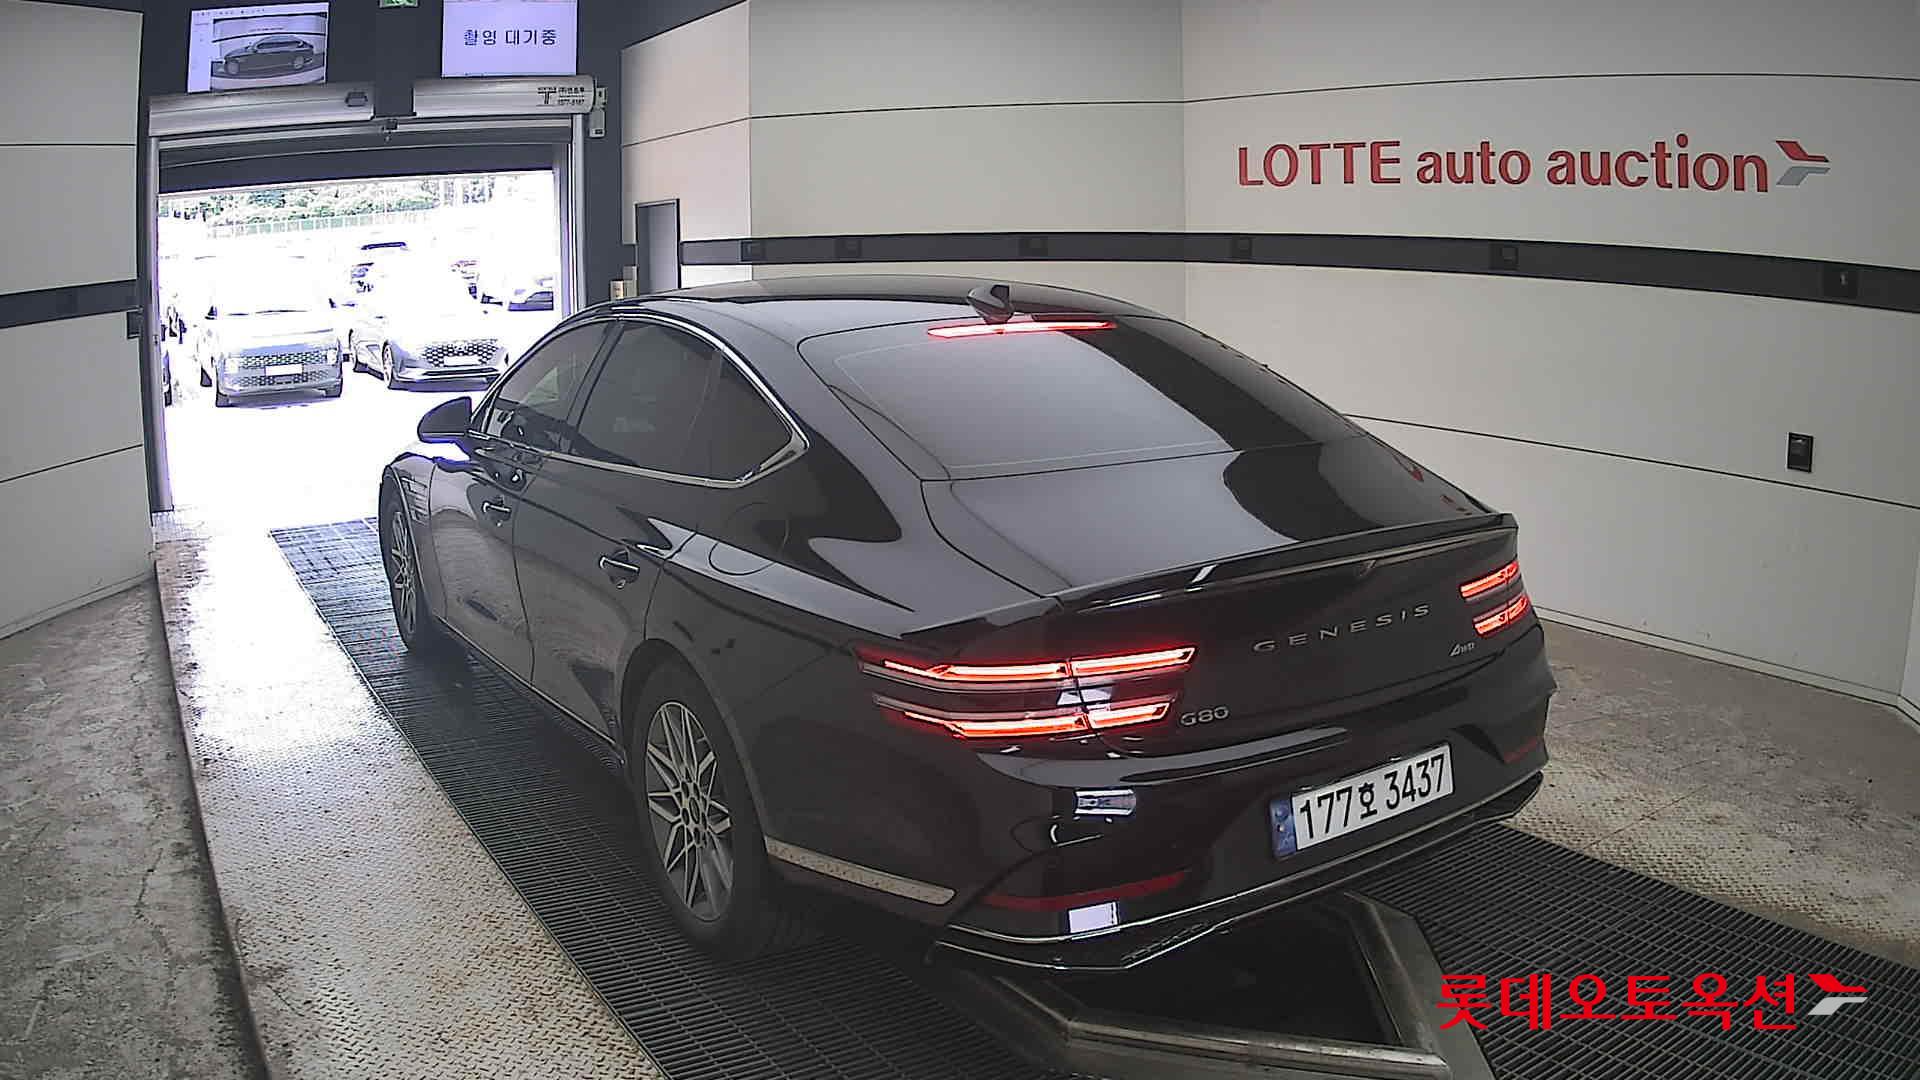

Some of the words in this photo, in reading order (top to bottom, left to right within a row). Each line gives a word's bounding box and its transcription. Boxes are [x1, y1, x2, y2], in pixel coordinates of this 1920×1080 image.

[505, 29, 557, 46] 대기중
[1238, 140, 1401, 187] LOTTE
[1416, 141, 1531, 185] auto
[1549, 133, 1768, 193] auction
[1253, 603, 1430, 652] GENESIS
[1180, 706, 1230, 727] G80
[1299, 782, 1377, 839] 177호
[1384, 754, 1444, 810] 3437
